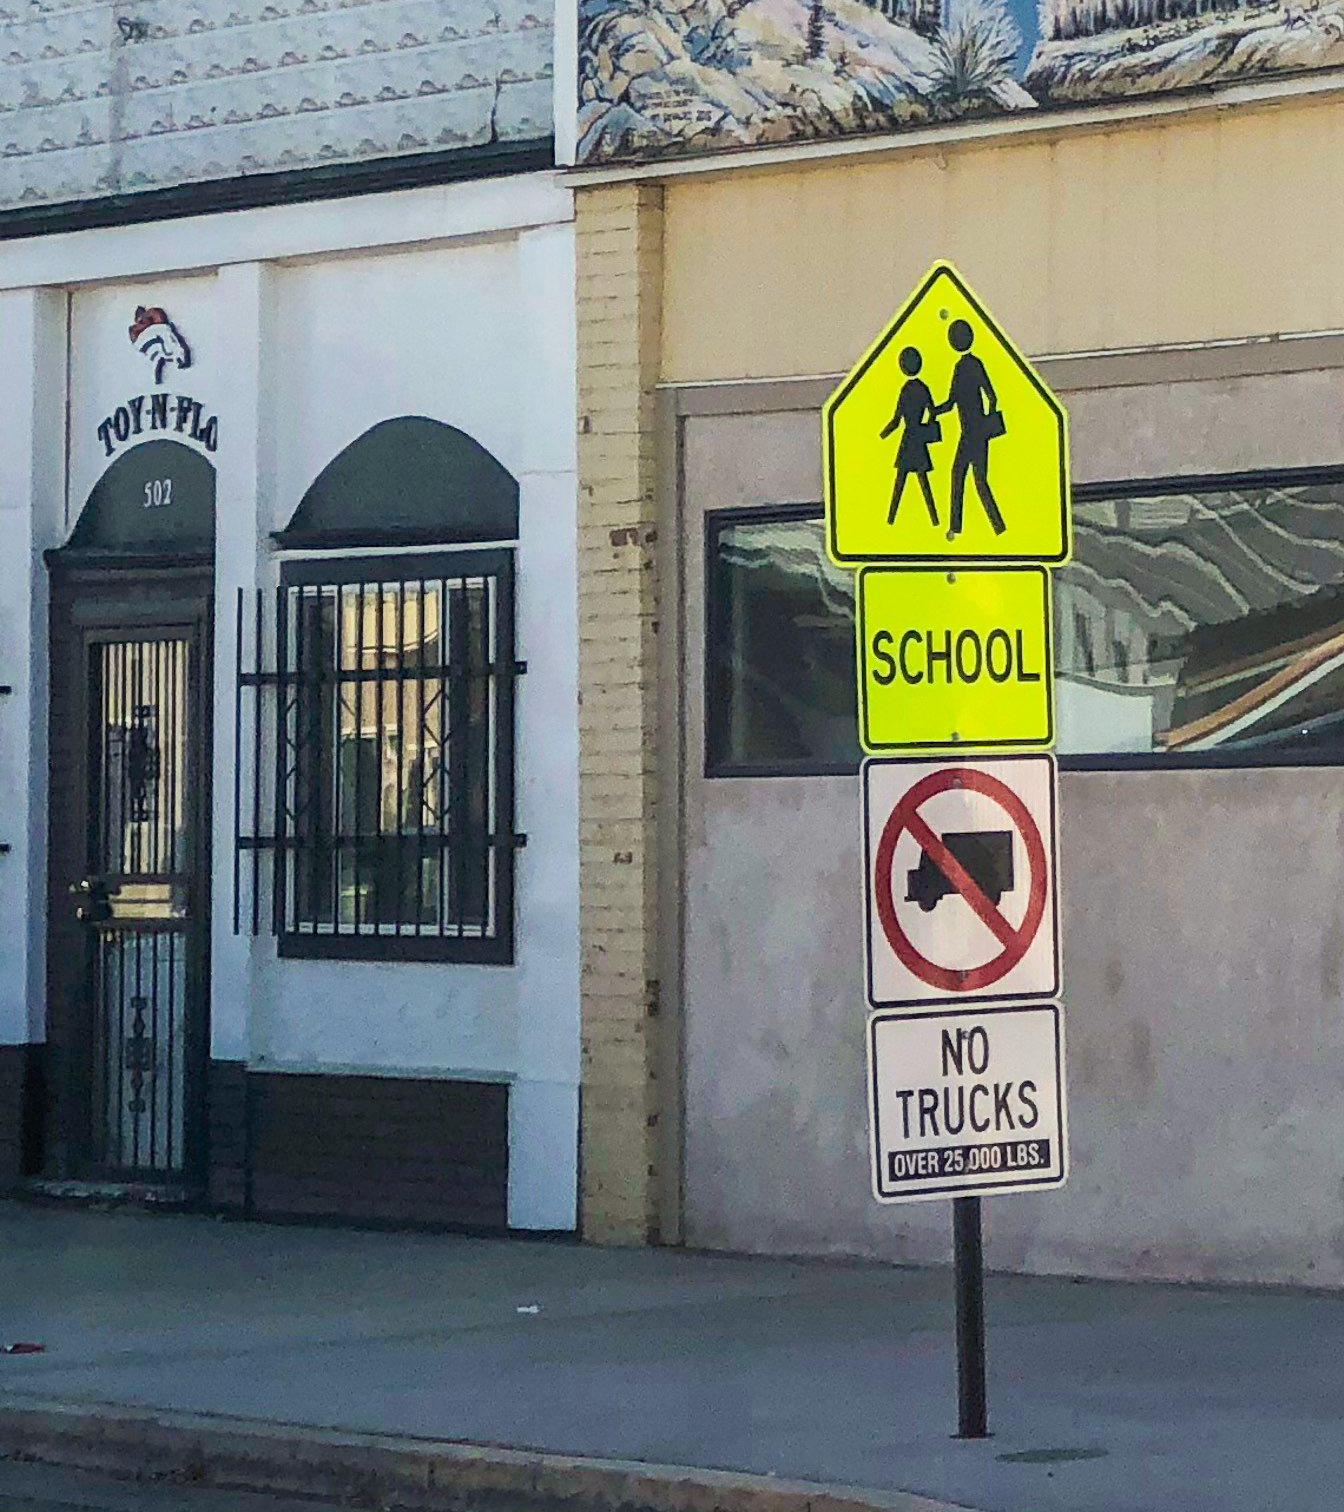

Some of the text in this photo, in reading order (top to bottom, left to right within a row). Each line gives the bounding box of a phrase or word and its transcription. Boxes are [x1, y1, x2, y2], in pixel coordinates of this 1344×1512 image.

[144, 478, 172, 507] 502
[872, 628, 1041, 686] SCHOOL
[941, 1025, 990, 1077] NO
[896, 1080, 1039, 1139] TRUCKS
[894, 1152, 940, 1177] OVER
[1006, 1142, 1045, 1167] LBS.
